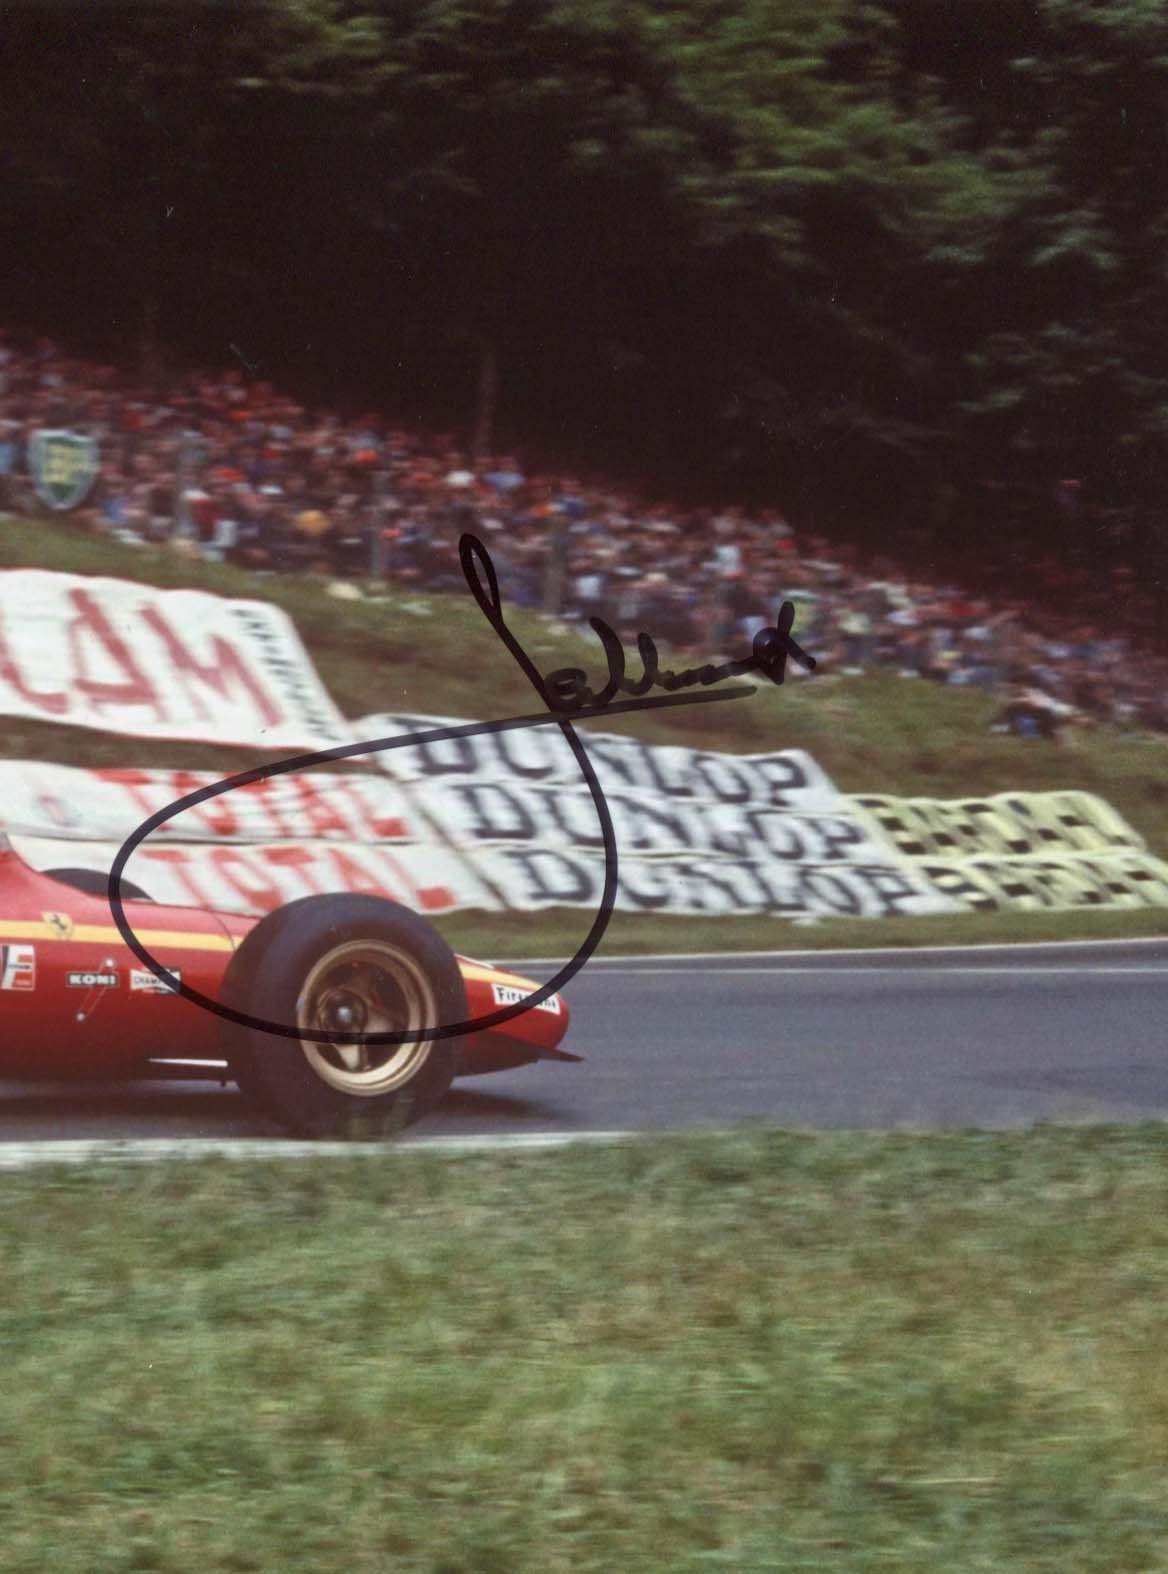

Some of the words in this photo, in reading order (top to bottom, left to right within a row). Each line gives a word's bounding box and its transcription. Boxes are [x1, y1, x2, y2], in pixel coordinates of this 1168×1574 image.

[388, 715, 809, 807] DUNLOP
[89, 769, 409, 838] TOTAL
[448, 782, 863, 860] DUNLOP
[138, 847, 457, 912] TOTAL
[502, 850, 920, 916] DUNLOP
[68, 974, 117, 985] KONI
